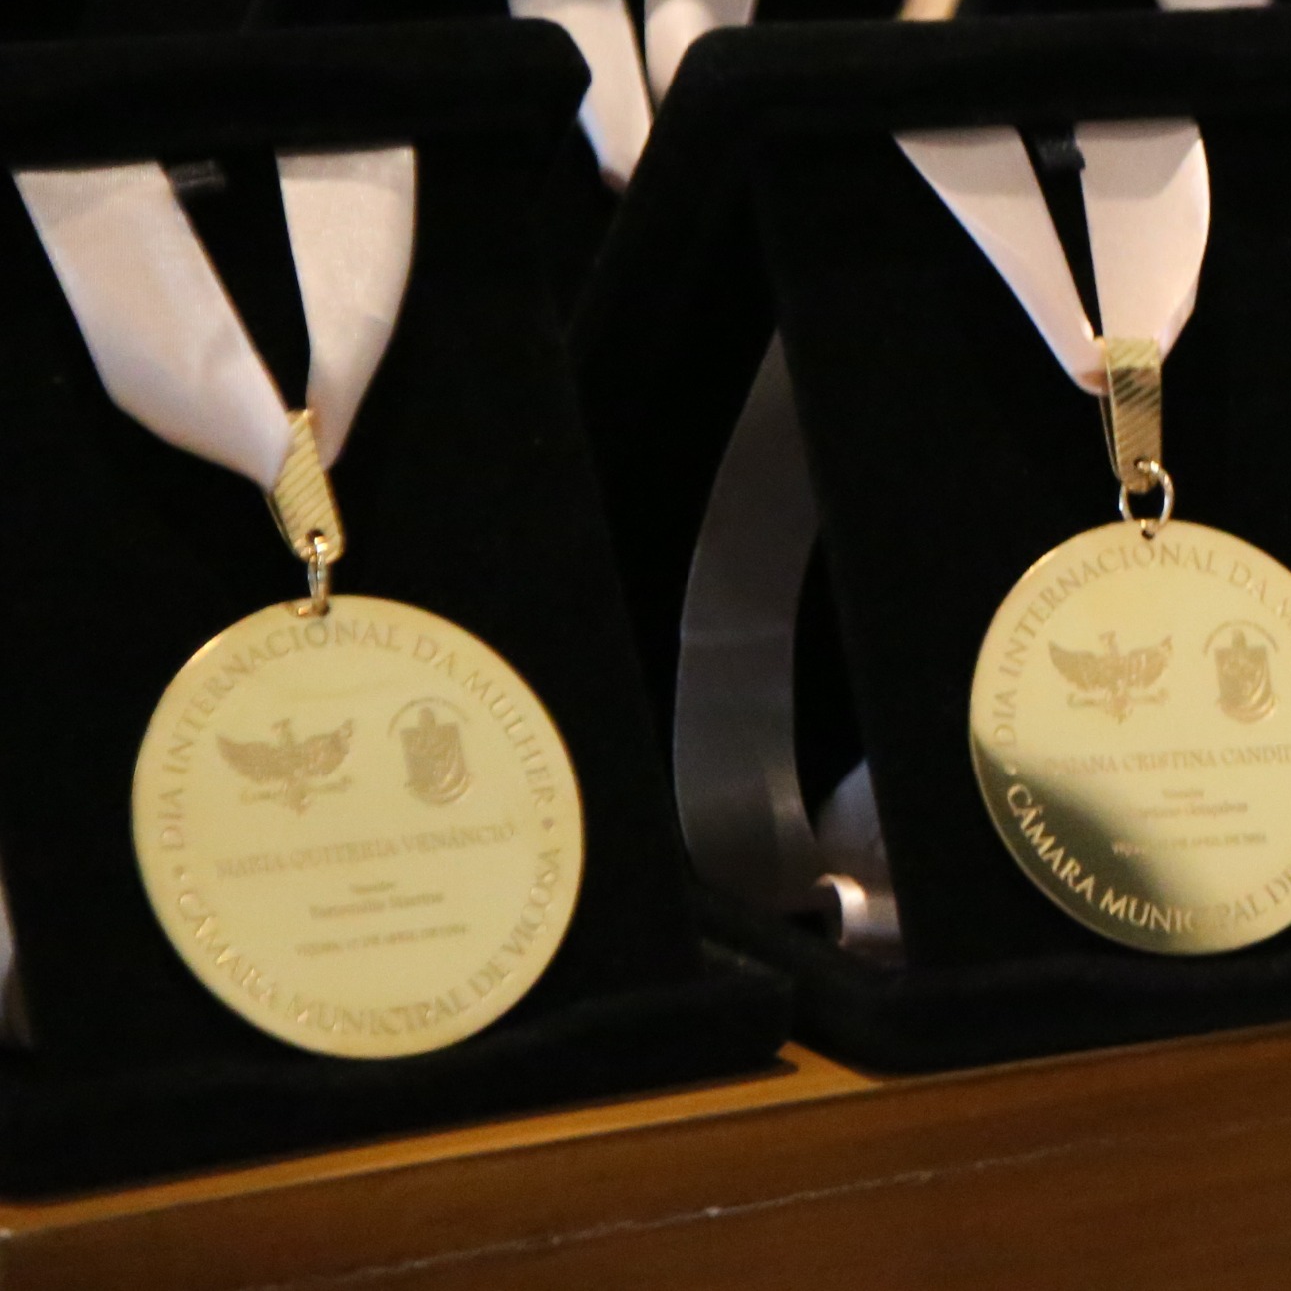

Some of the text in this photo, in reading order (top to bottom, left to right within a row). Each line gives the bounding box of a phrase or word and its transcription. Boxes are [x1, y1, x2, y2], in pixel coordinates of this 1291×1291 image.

[1004, 541, 1219, 679] INTERNACIONAL
[1228, 558, 1271, 605] DA
[159, 618, 558, 852] DIA INTERNACIONAL DA MULHER
[994, 689, 1018, 748] DIA
[1006, 783, 1098, 903] CÂMARA
[1098, 885, 1267, 935] MUNICPAL
